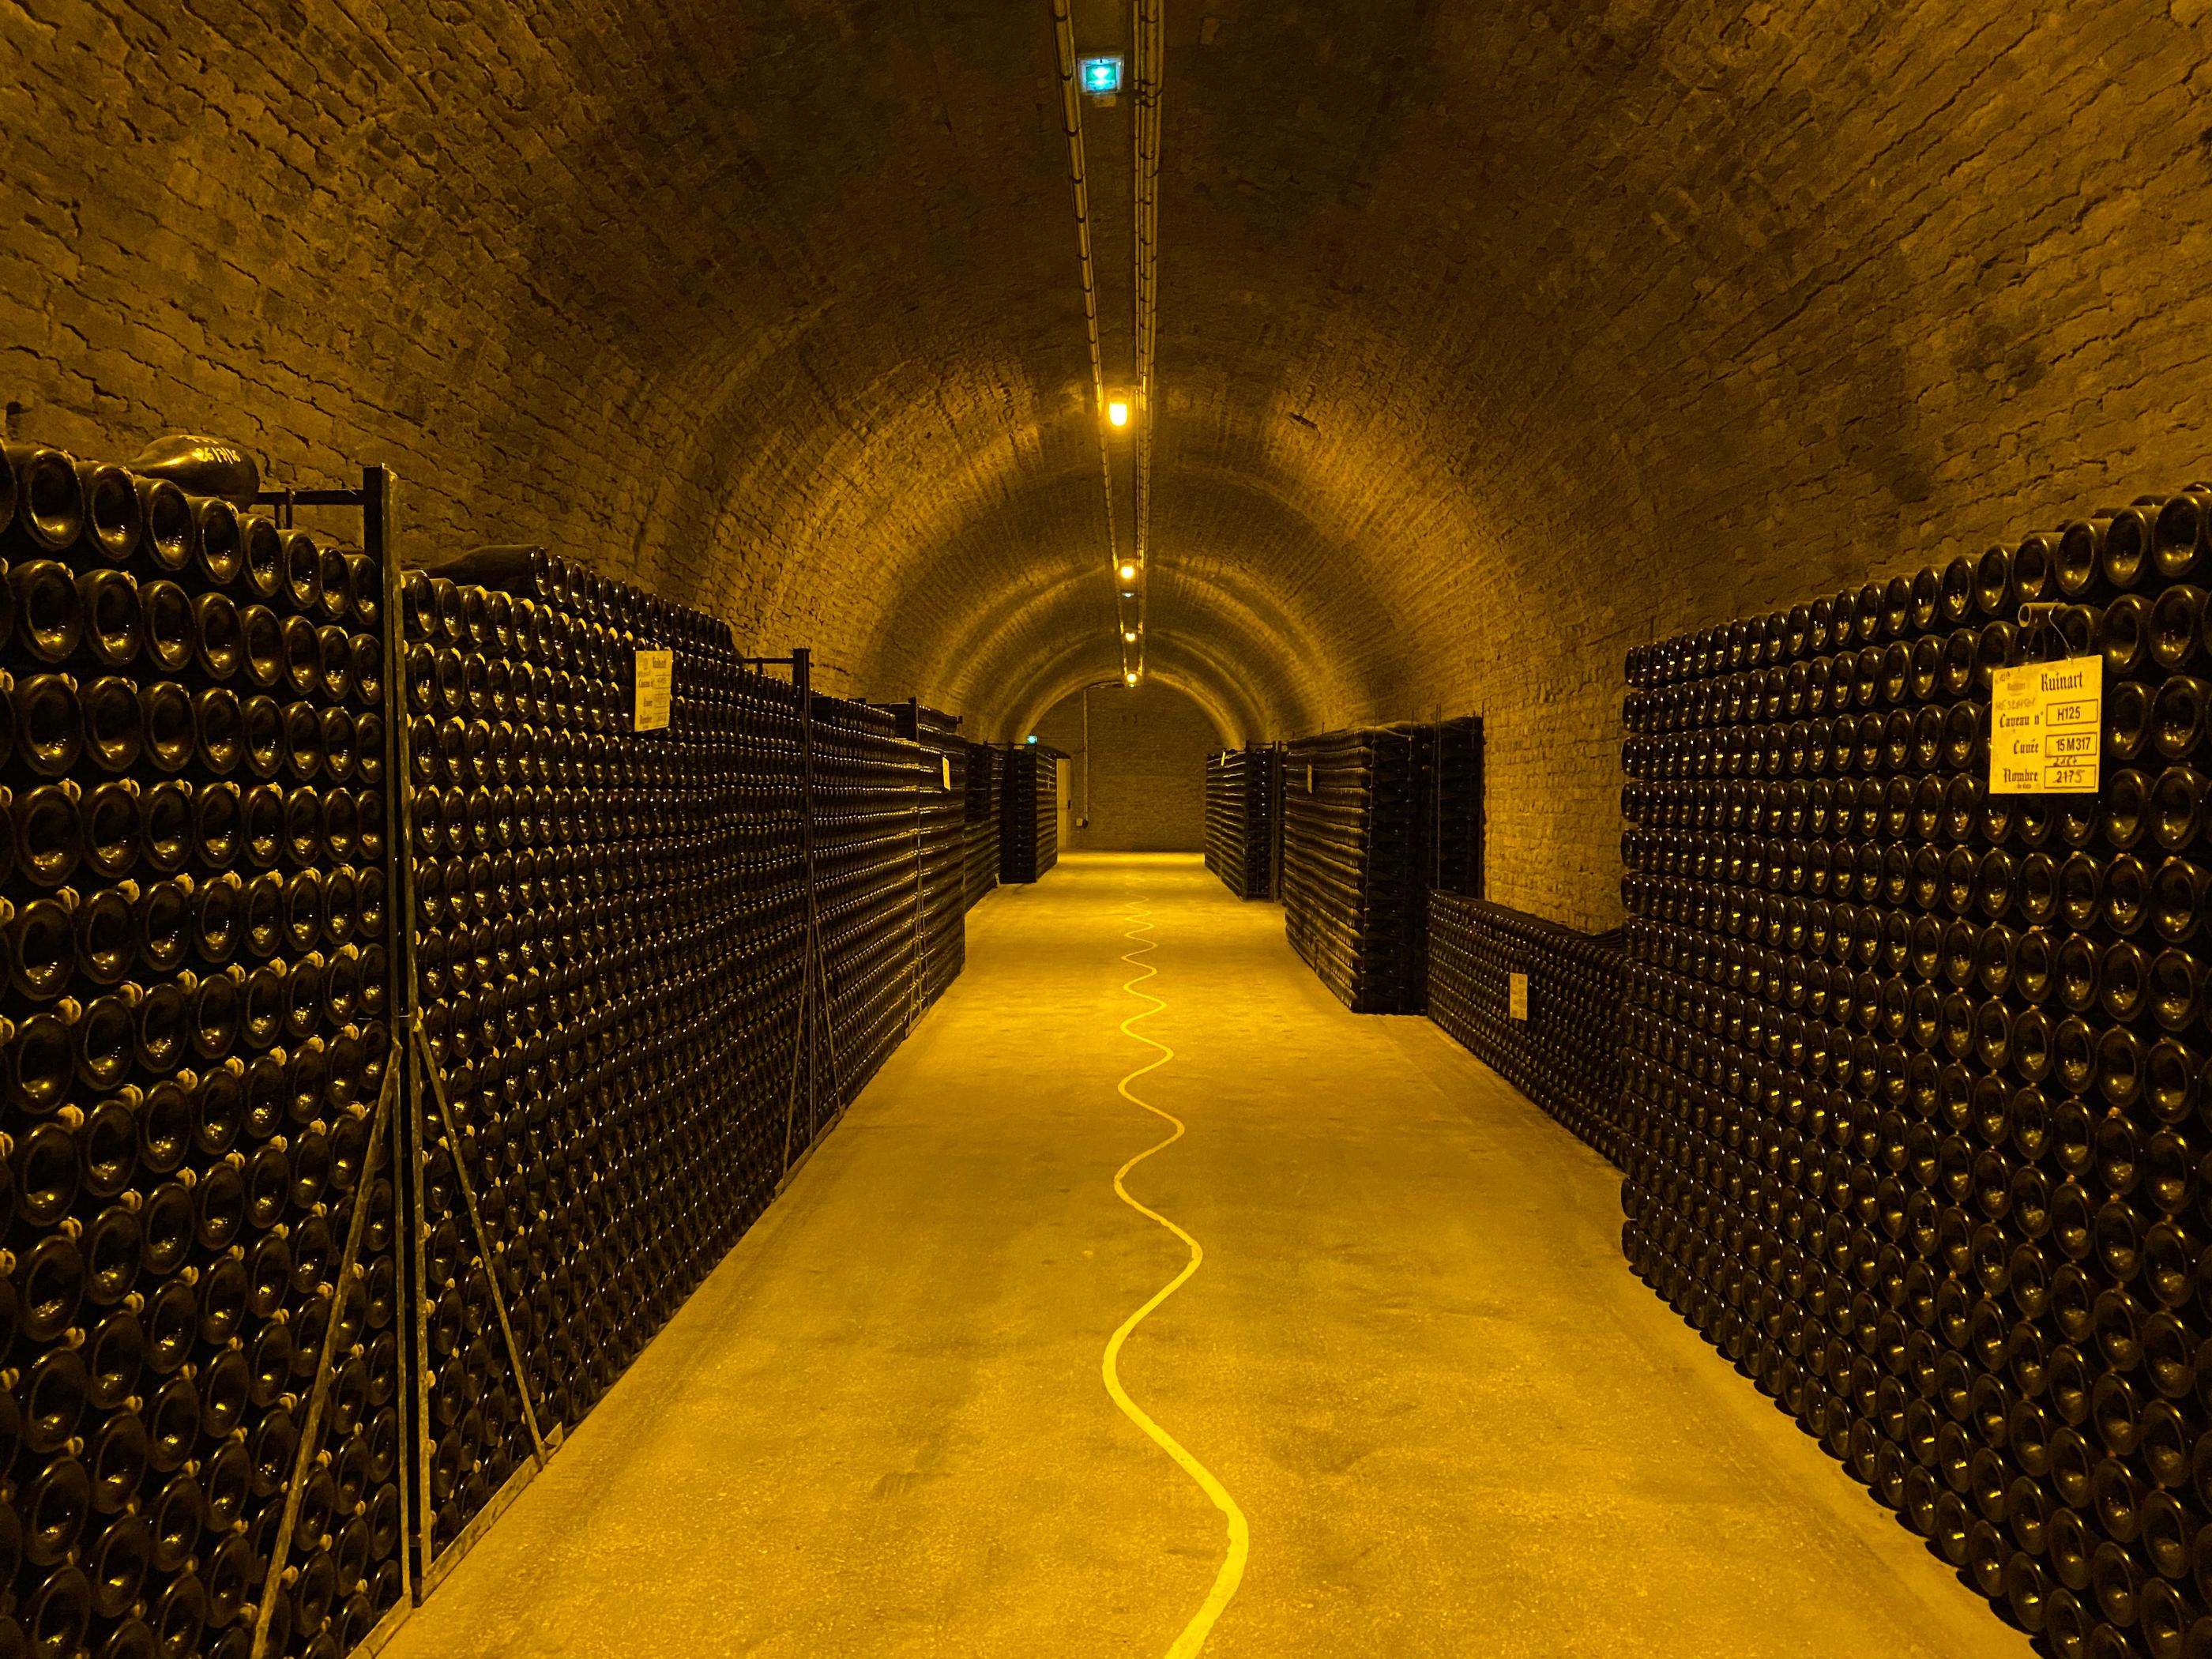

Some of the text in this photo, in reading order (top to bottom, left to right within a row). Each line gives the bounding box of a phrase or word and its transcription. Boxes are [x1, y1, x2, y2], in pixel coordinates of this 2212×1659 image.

[2041, 671, 2083, 693] Ruinart
[1999, 713, 2030, 728] Caveau
[2057, 706, 2081, 720] H125
[2013, 739, 2039, 754] Cuvée
[2003, 767, 2038, 782] Nombre
